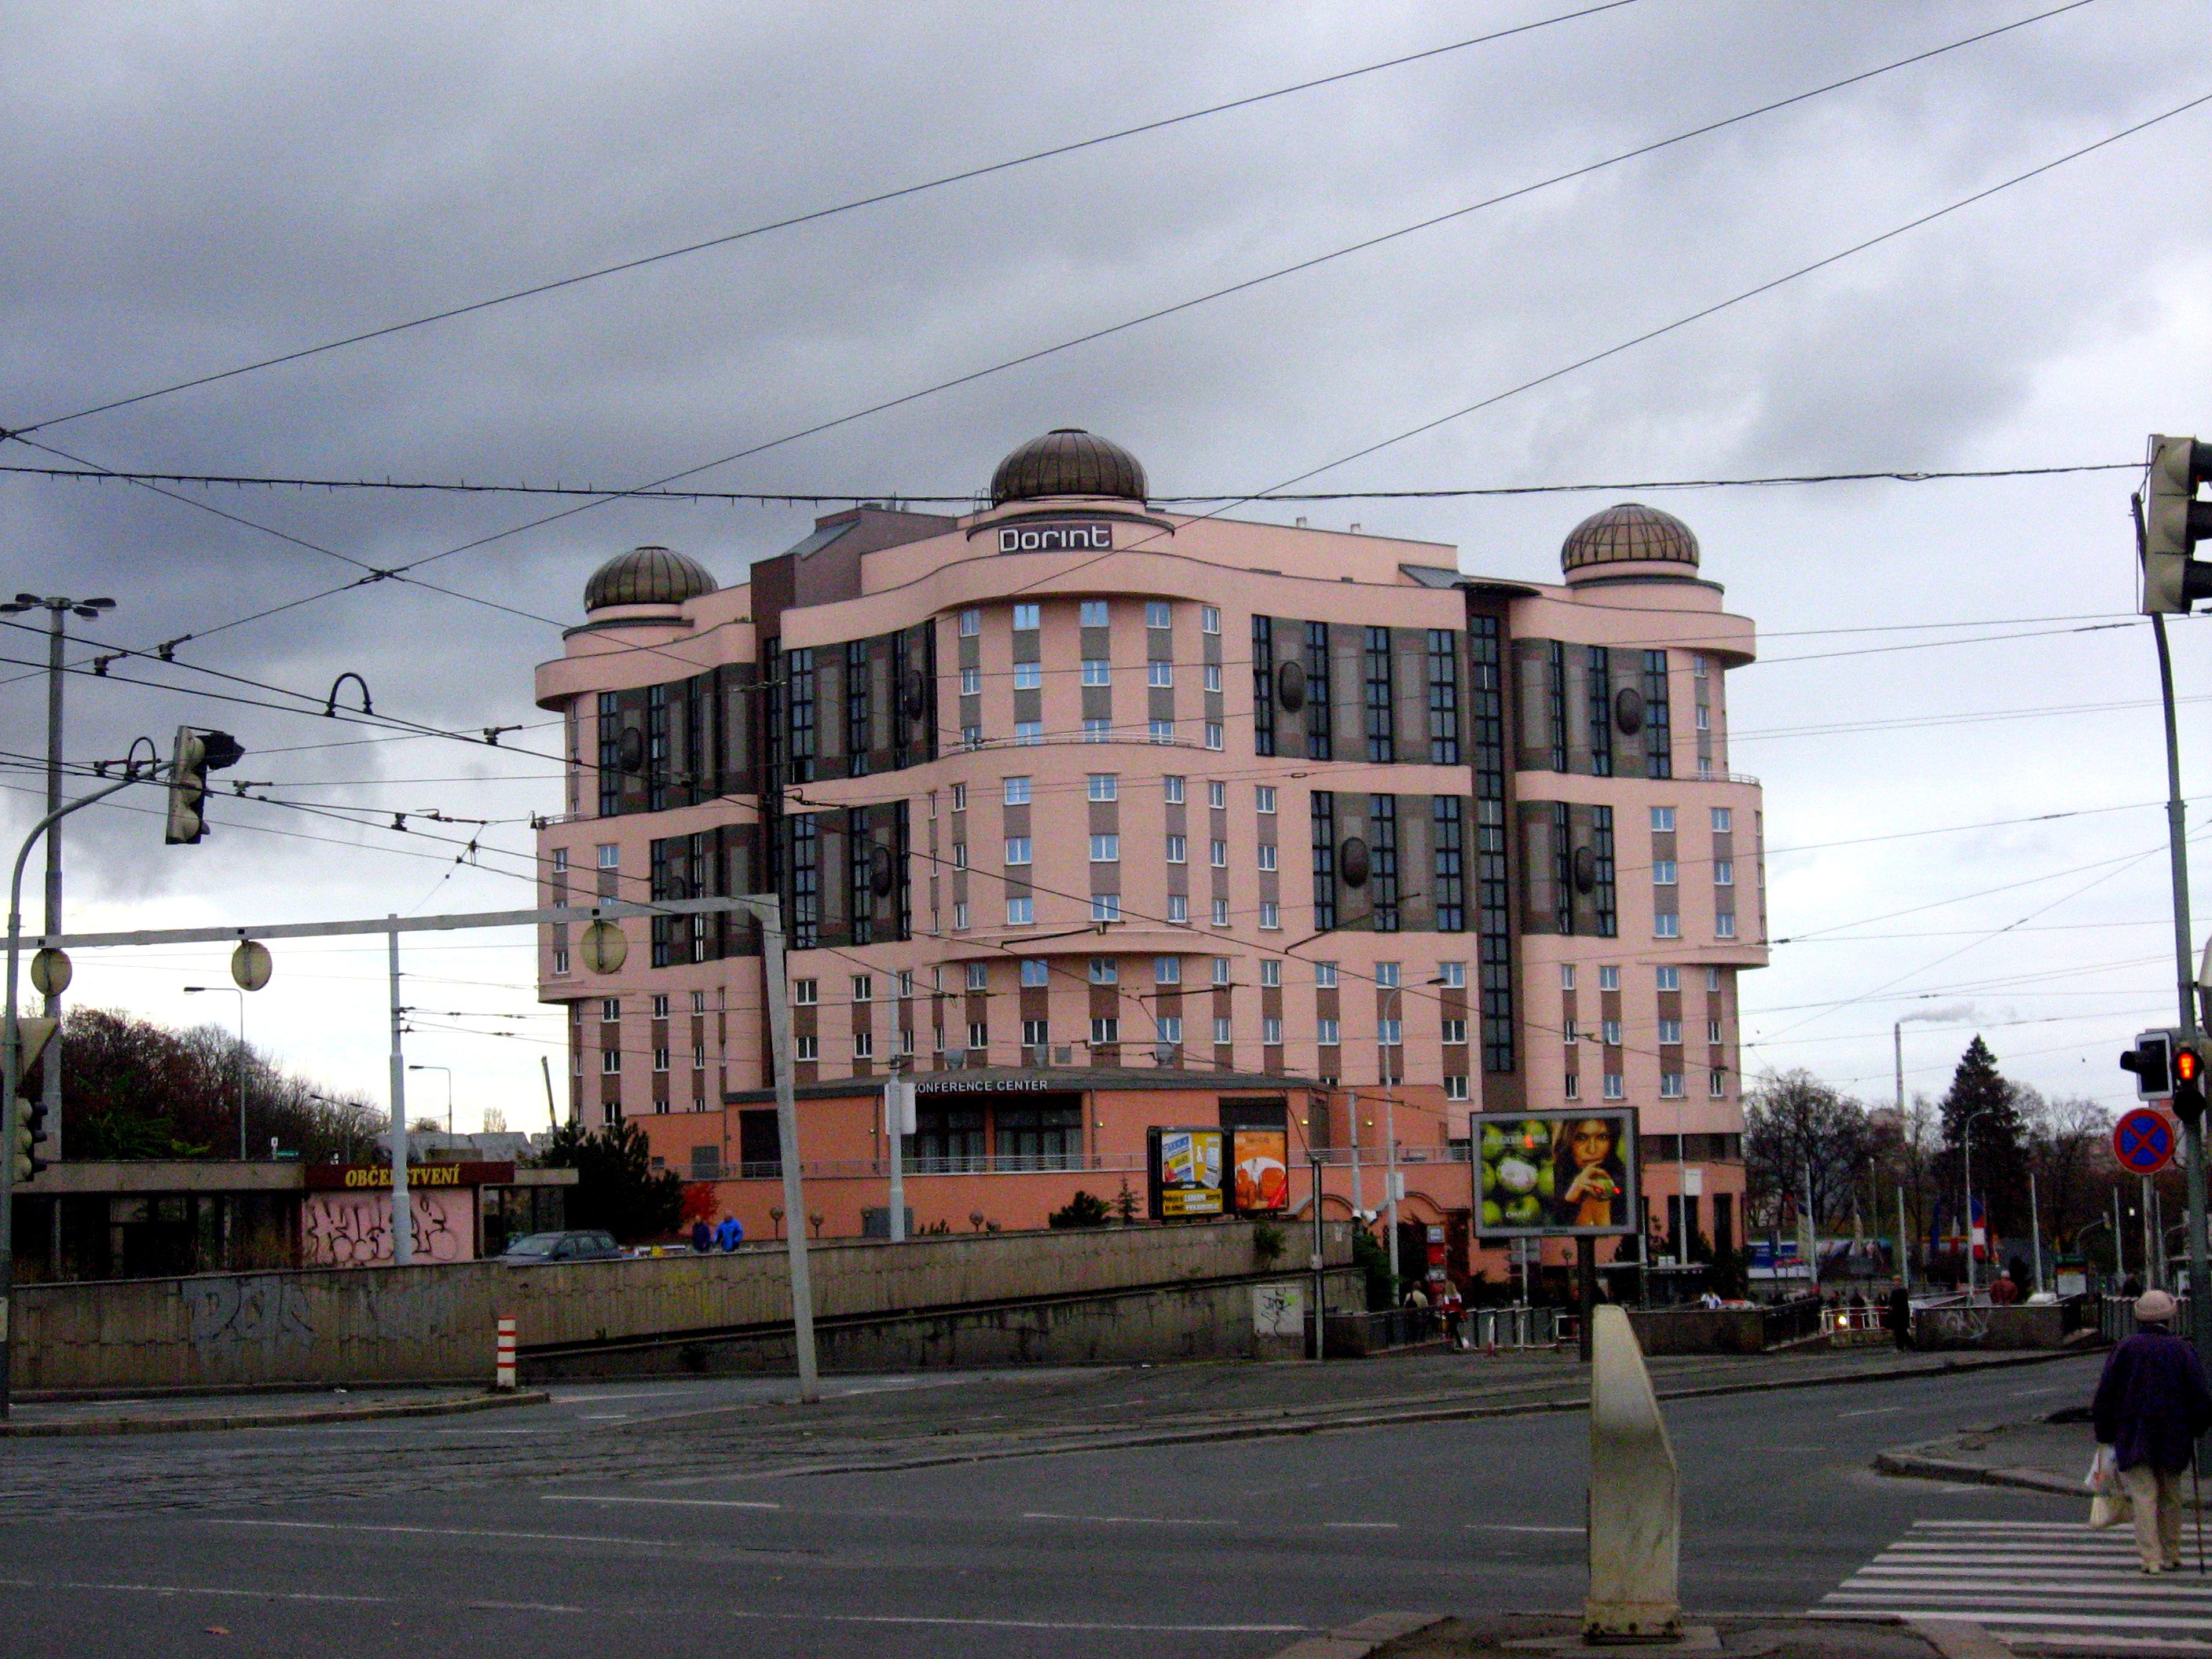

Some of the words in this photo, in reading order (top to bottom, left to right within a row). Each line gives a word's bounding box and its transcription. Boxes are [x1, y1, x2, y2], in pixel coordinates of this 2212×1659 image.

[999, 525, 1110, 552] Dorint
[915, 1081, 993, 1093] ONFERENCE
[997, 1079, 1048, 1092] CENTER
[345, 1163, 460, 1187] OBČETVENÍ
